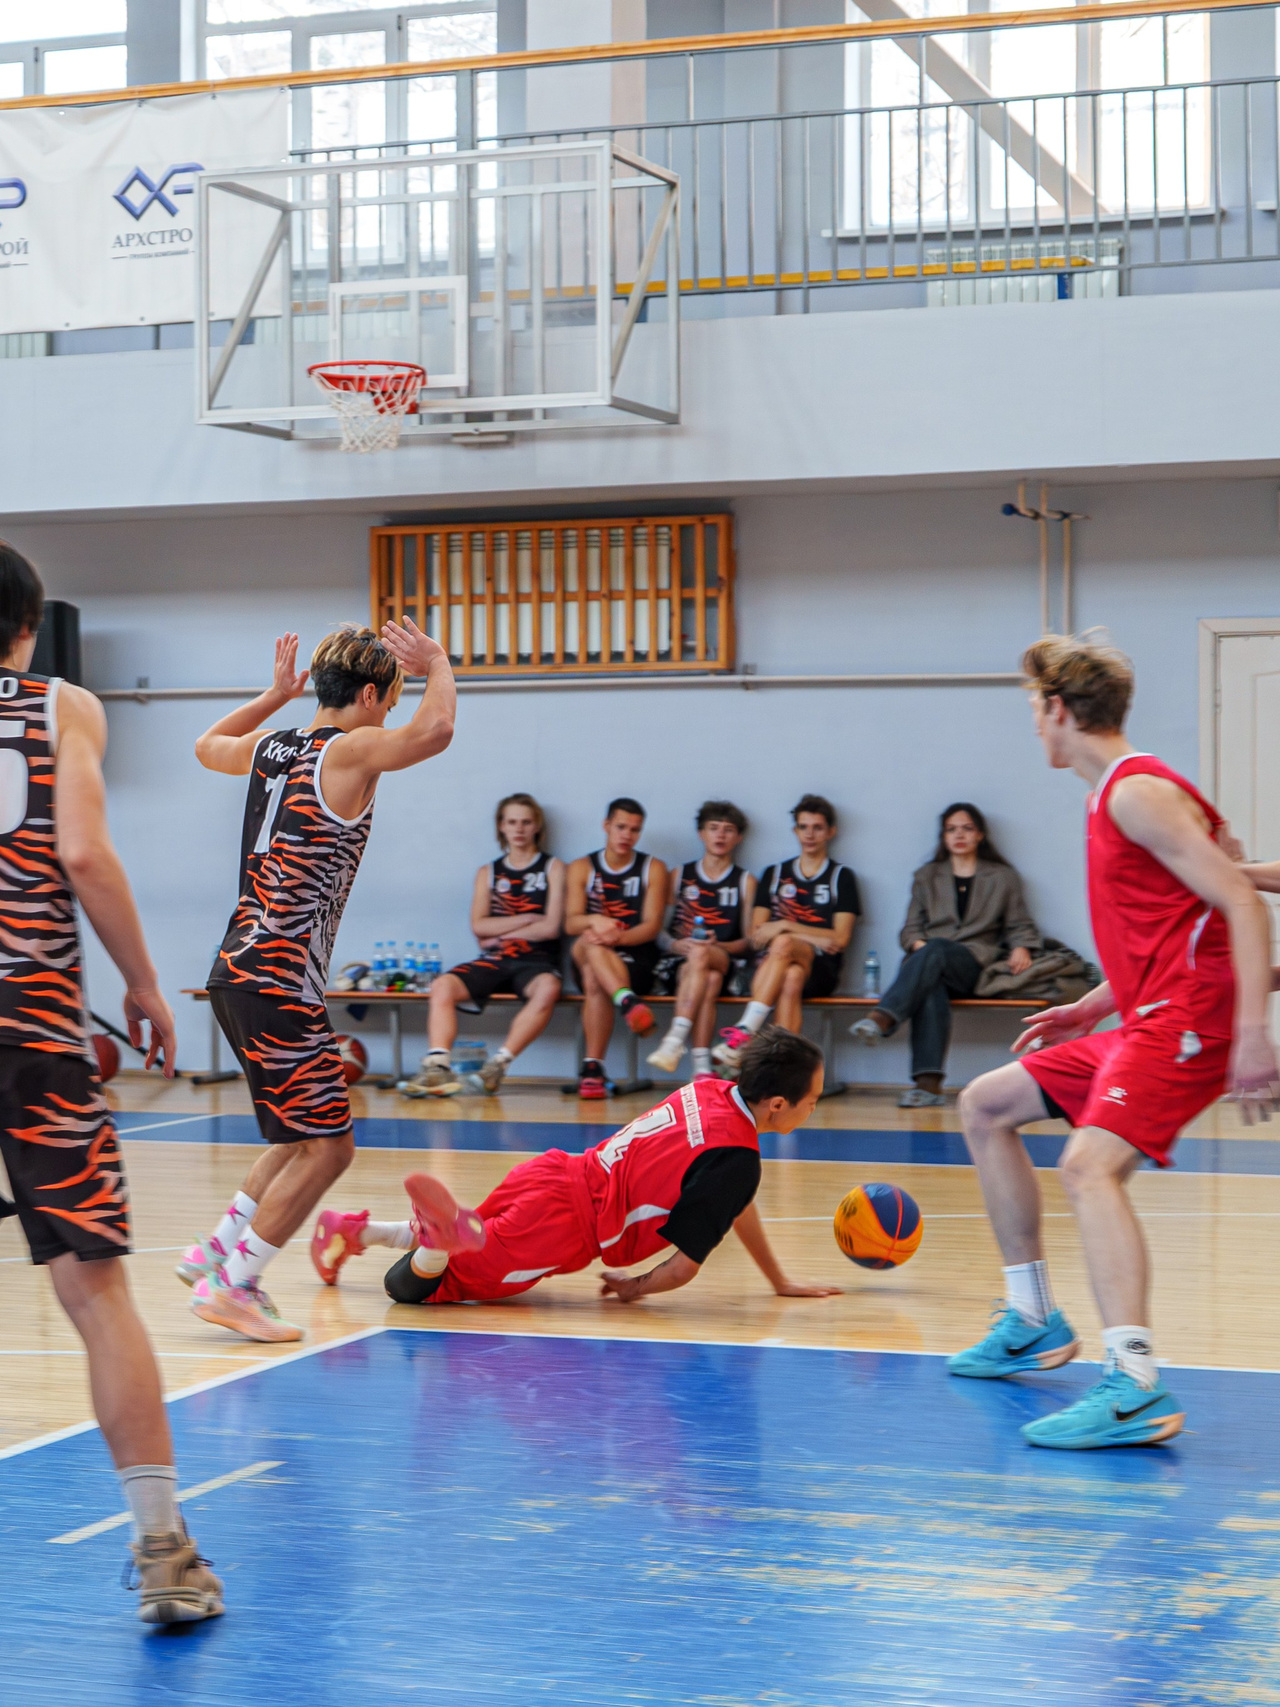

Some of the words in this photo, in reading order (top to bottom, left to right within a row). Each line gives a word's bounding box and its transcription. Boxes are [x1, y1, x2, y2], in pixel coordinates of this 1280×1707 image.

[111, 228, 194, 249] АРХСТРО
[523, 872, 547, 893] 24
[718, 886, 739, 907] 11
[814, 884, 830, 904] 5
